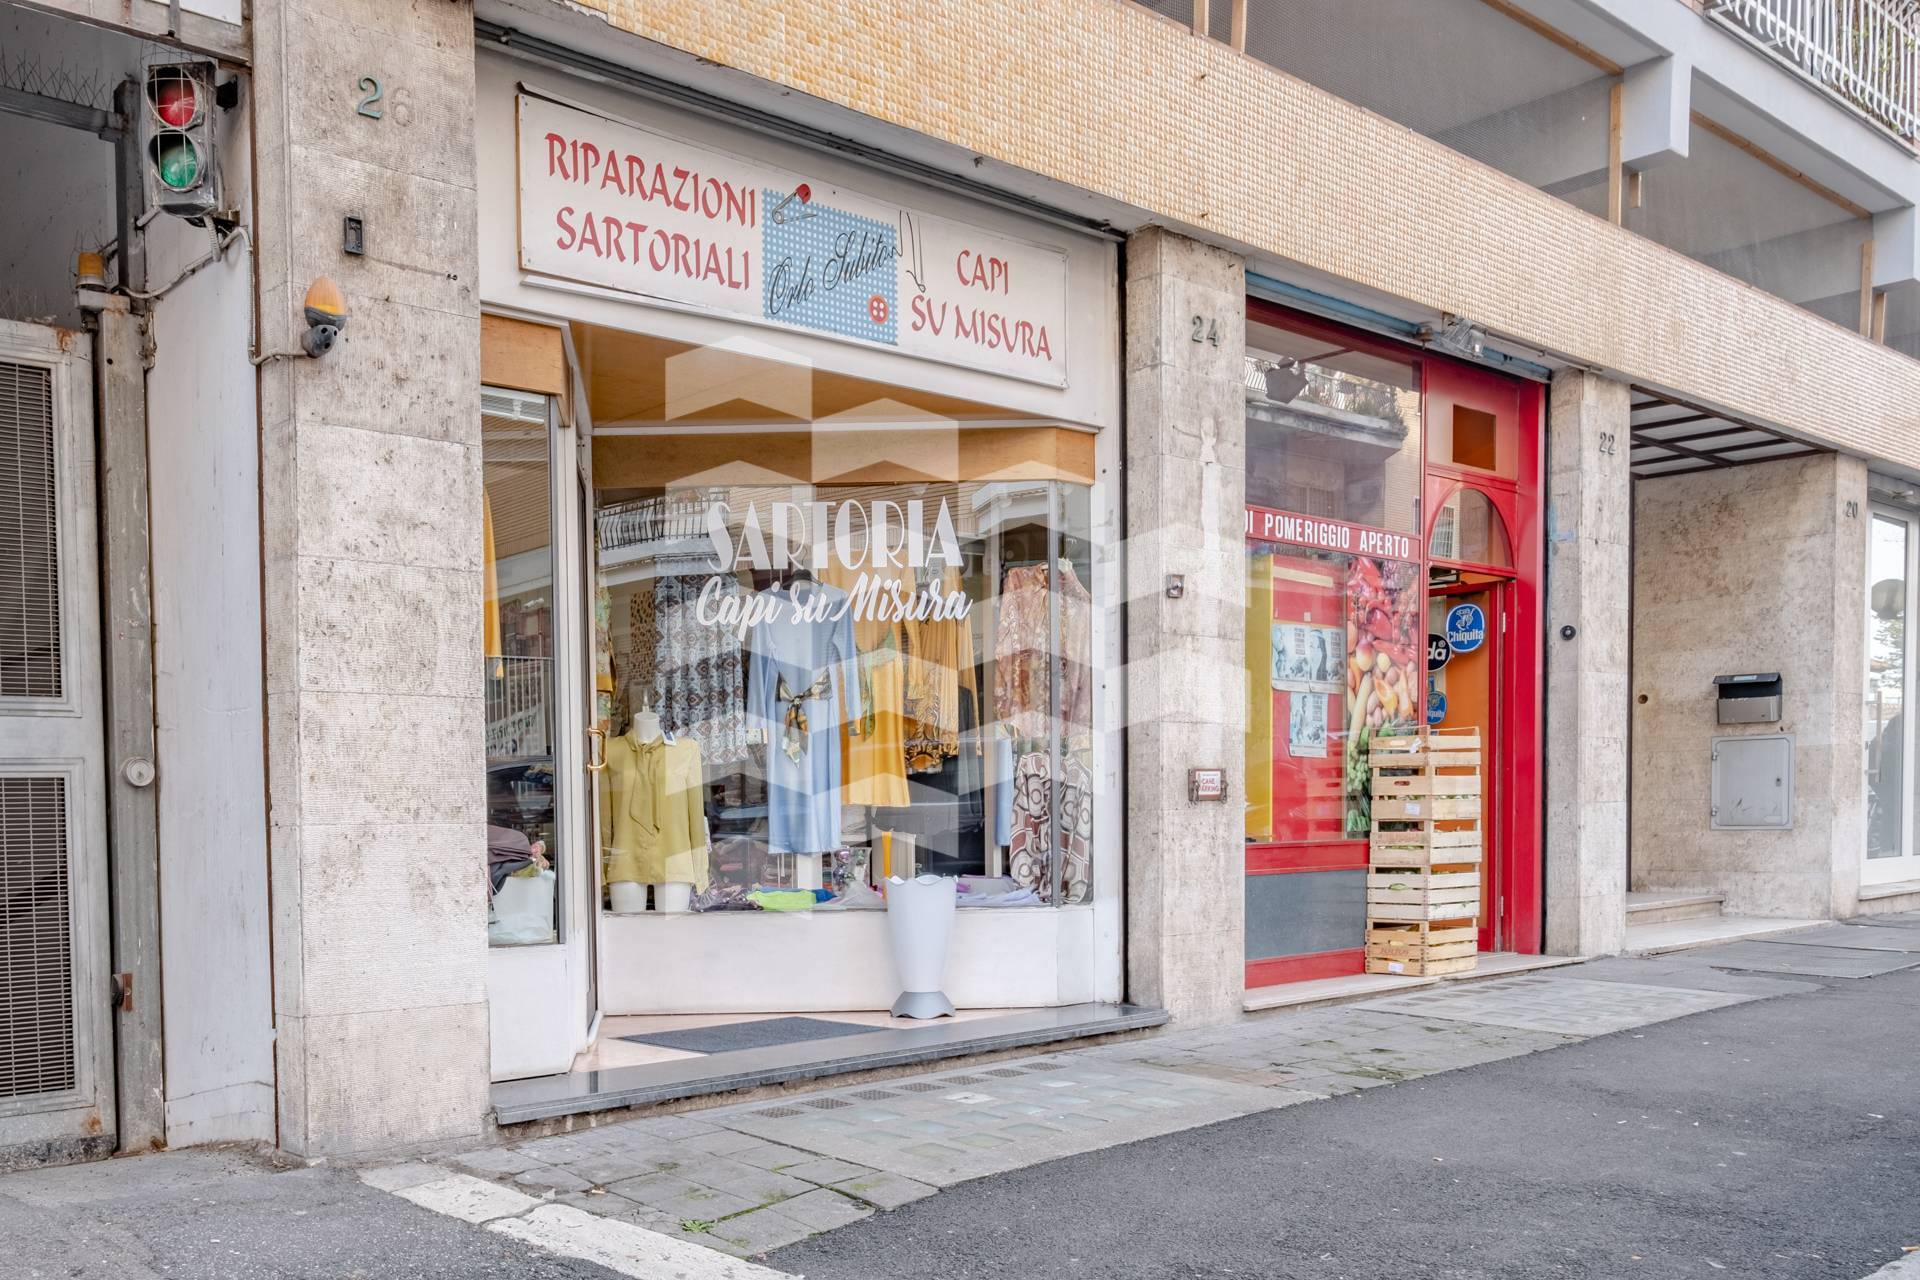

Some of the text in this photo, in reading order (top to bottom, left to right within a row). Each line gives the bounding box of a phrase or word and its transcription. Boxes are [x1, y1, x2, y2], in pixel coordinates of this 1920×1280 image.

[545, 132, 756, 229] RIPARAZIONI
[556, 206, 750, 291] SARTORIALI
[956, 250, 1009, 295] CAPI
[911, 294, 1053, 361] SU MISURA
[1191, 313, 1220, 347] 24
[1599, 431, 1616, 456] 22
[1846, 500, 1858, 519] 20
[707, 496, 964, 571] SARTORIA
[1264, 512, 1350, 549] POMERIGGIO
[1359, 530, 1410, 558] APERTO
[696, 575, 784, 641] Capi
[829, 571, 973, 622] Misura
[1447, 629, 1484, 645] Chiquita
